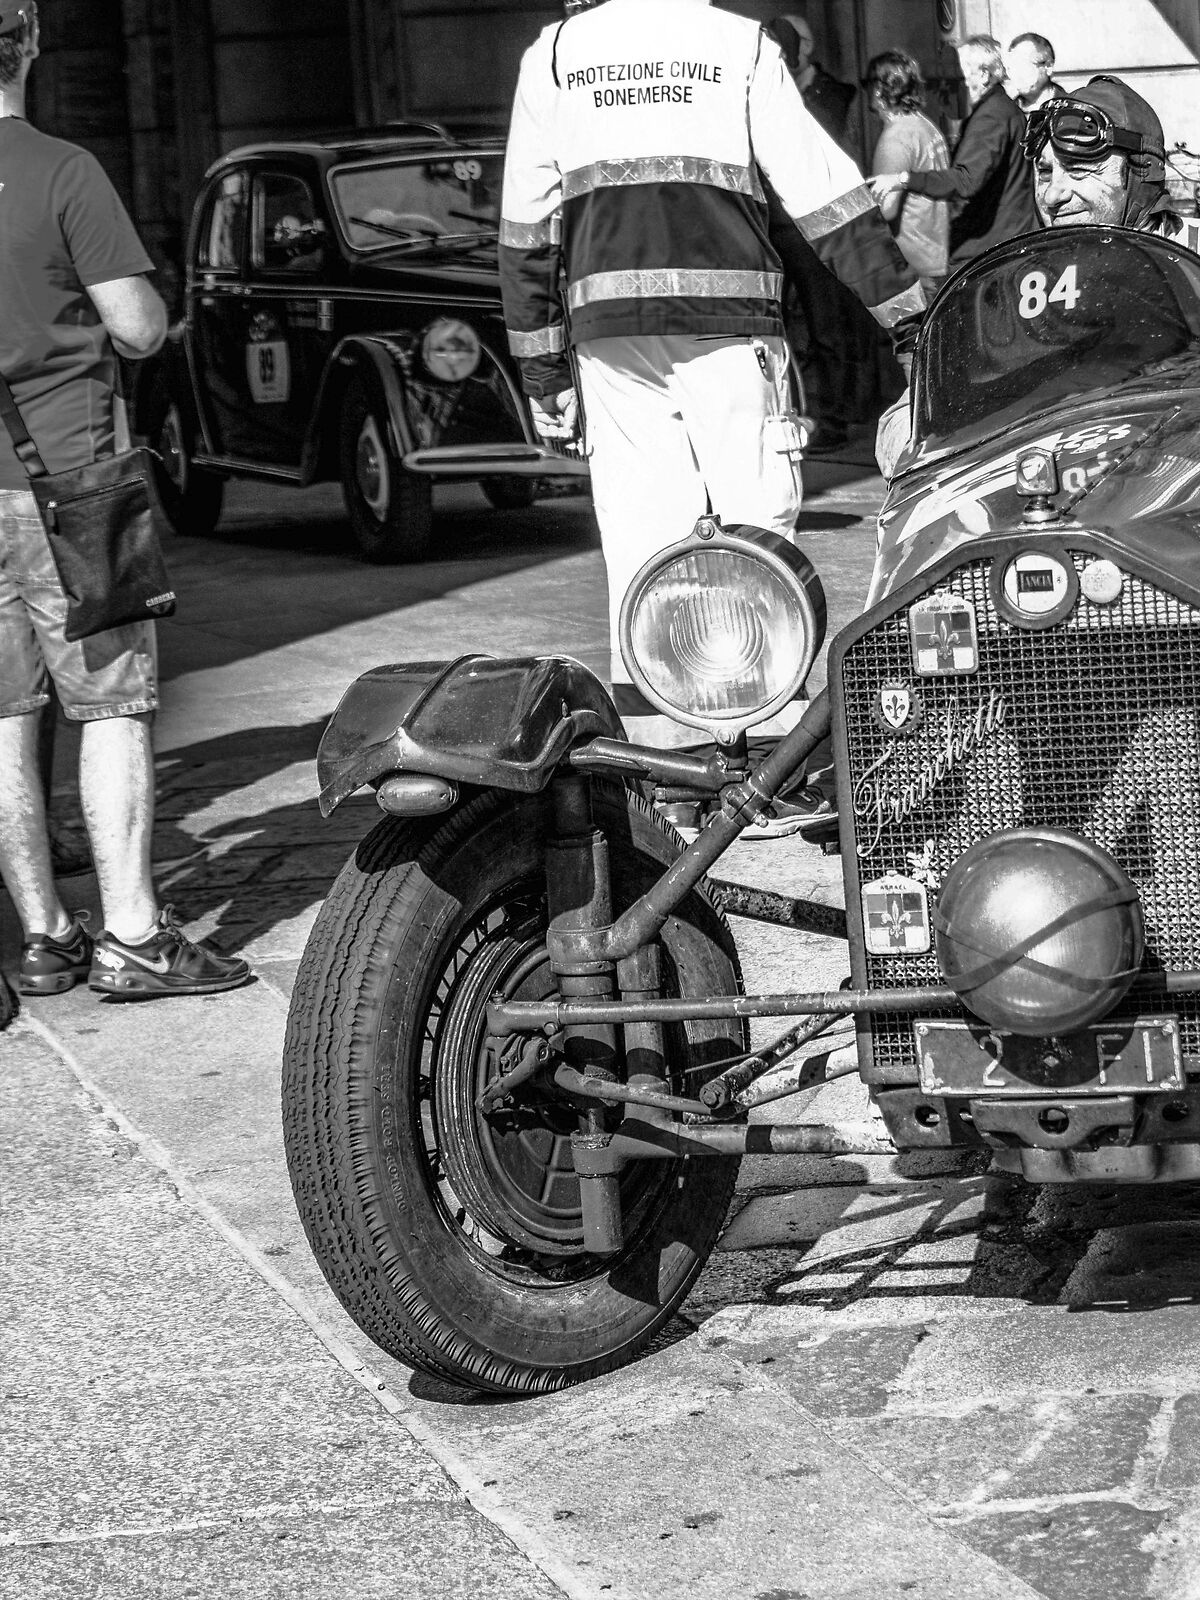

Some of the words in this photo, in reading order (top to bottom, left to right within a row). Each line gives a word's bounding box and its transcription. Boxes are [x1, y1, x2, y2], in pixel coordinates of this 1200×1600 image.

[567, 62, 664, 90] PROTEZIONE
[670, 61, 722, 83] CIVILE
[594, 85, 693, 108] BONEMERSE
[453, 160, 482, 180] 89
[1018, 264, 1082, 319] 84
[1020, 573, 1052, 591] LANCIA
